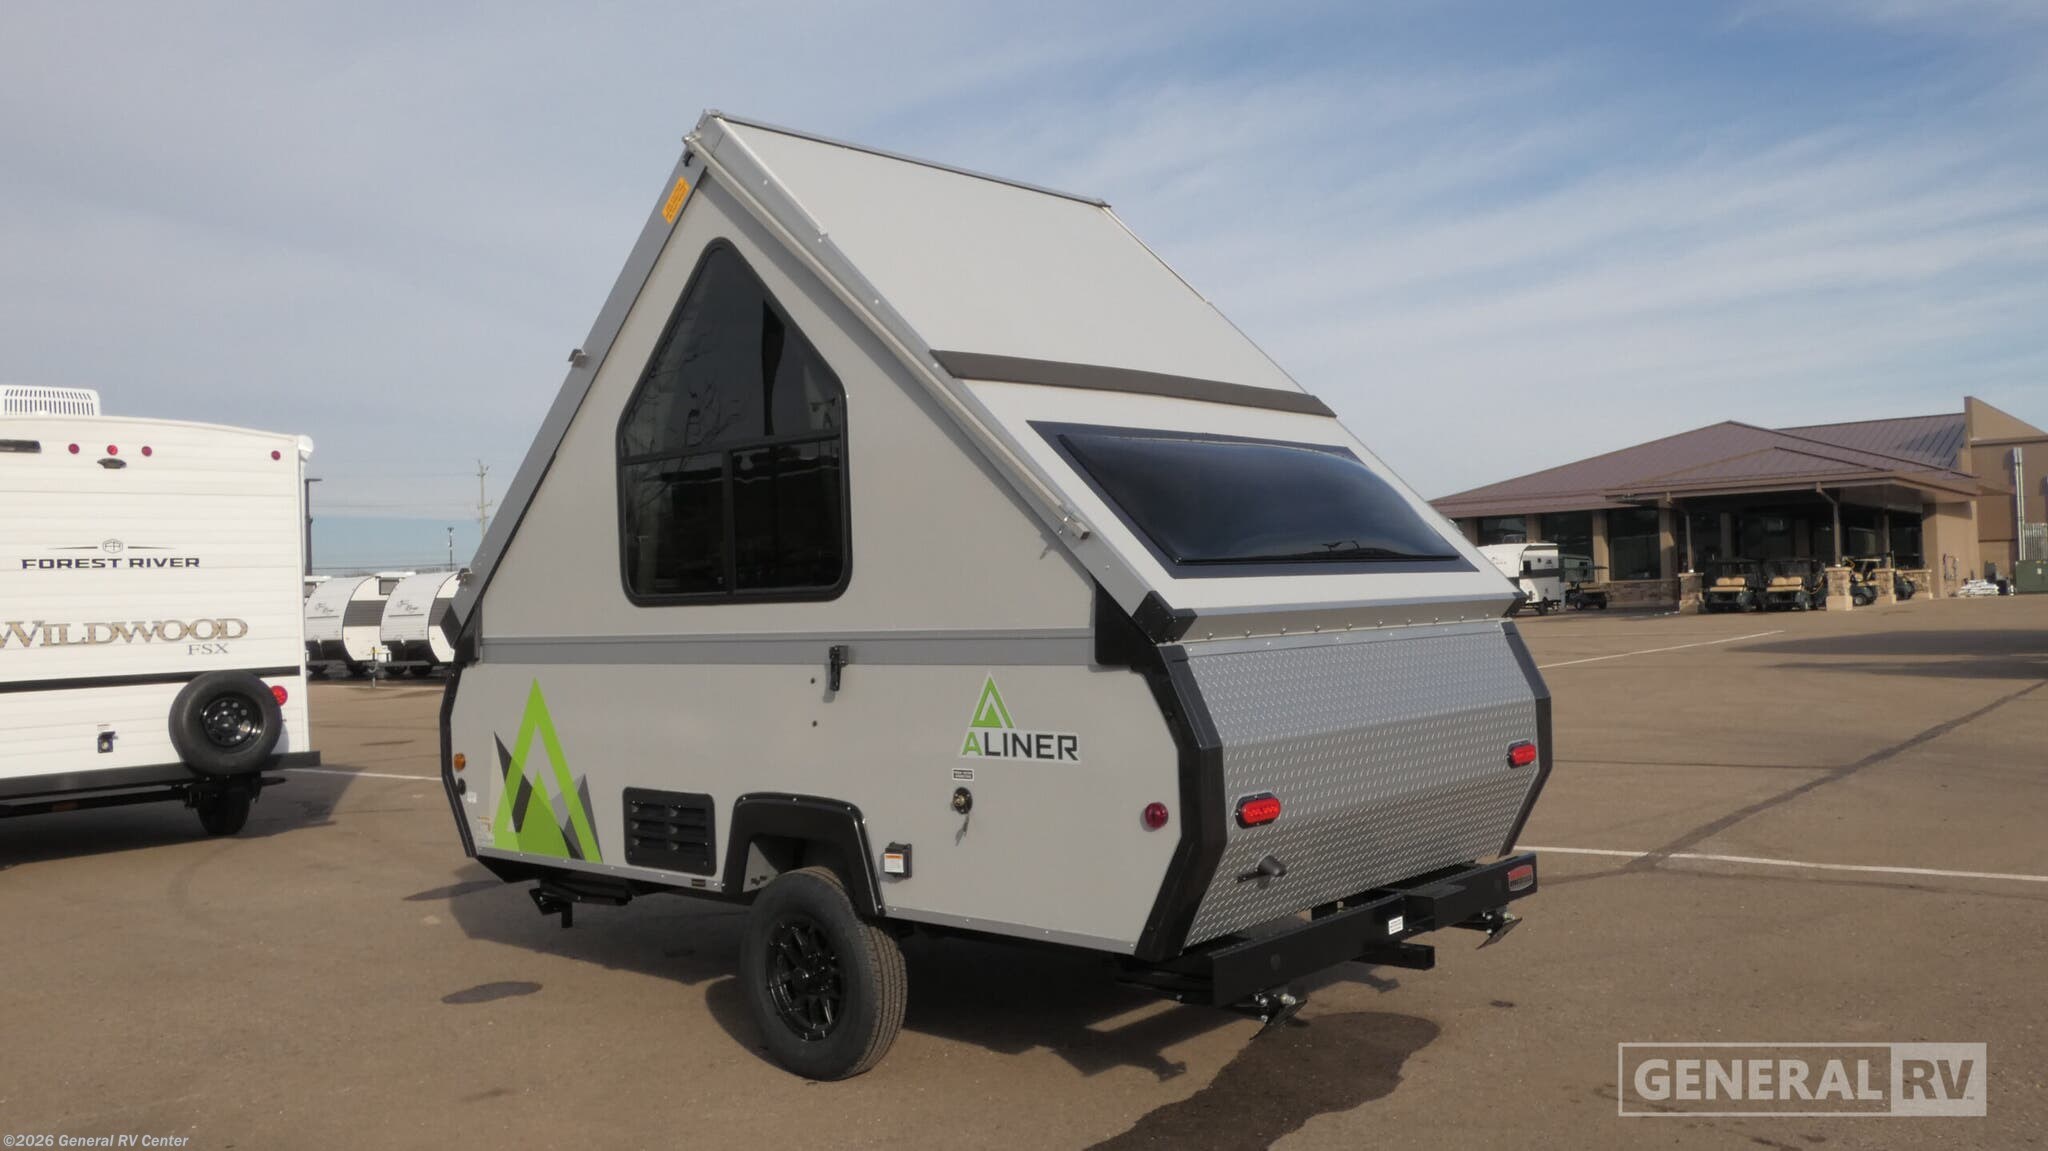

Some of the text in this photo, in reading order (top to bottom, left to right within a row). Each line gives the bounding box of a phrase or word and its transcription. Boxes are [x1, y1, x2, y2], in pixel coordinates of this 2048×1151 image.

[21, 557, 200, 569] FOREST RIVER
[187, 643, 230, 656] FSX
[961, 731, 1079, 761] ALINER
